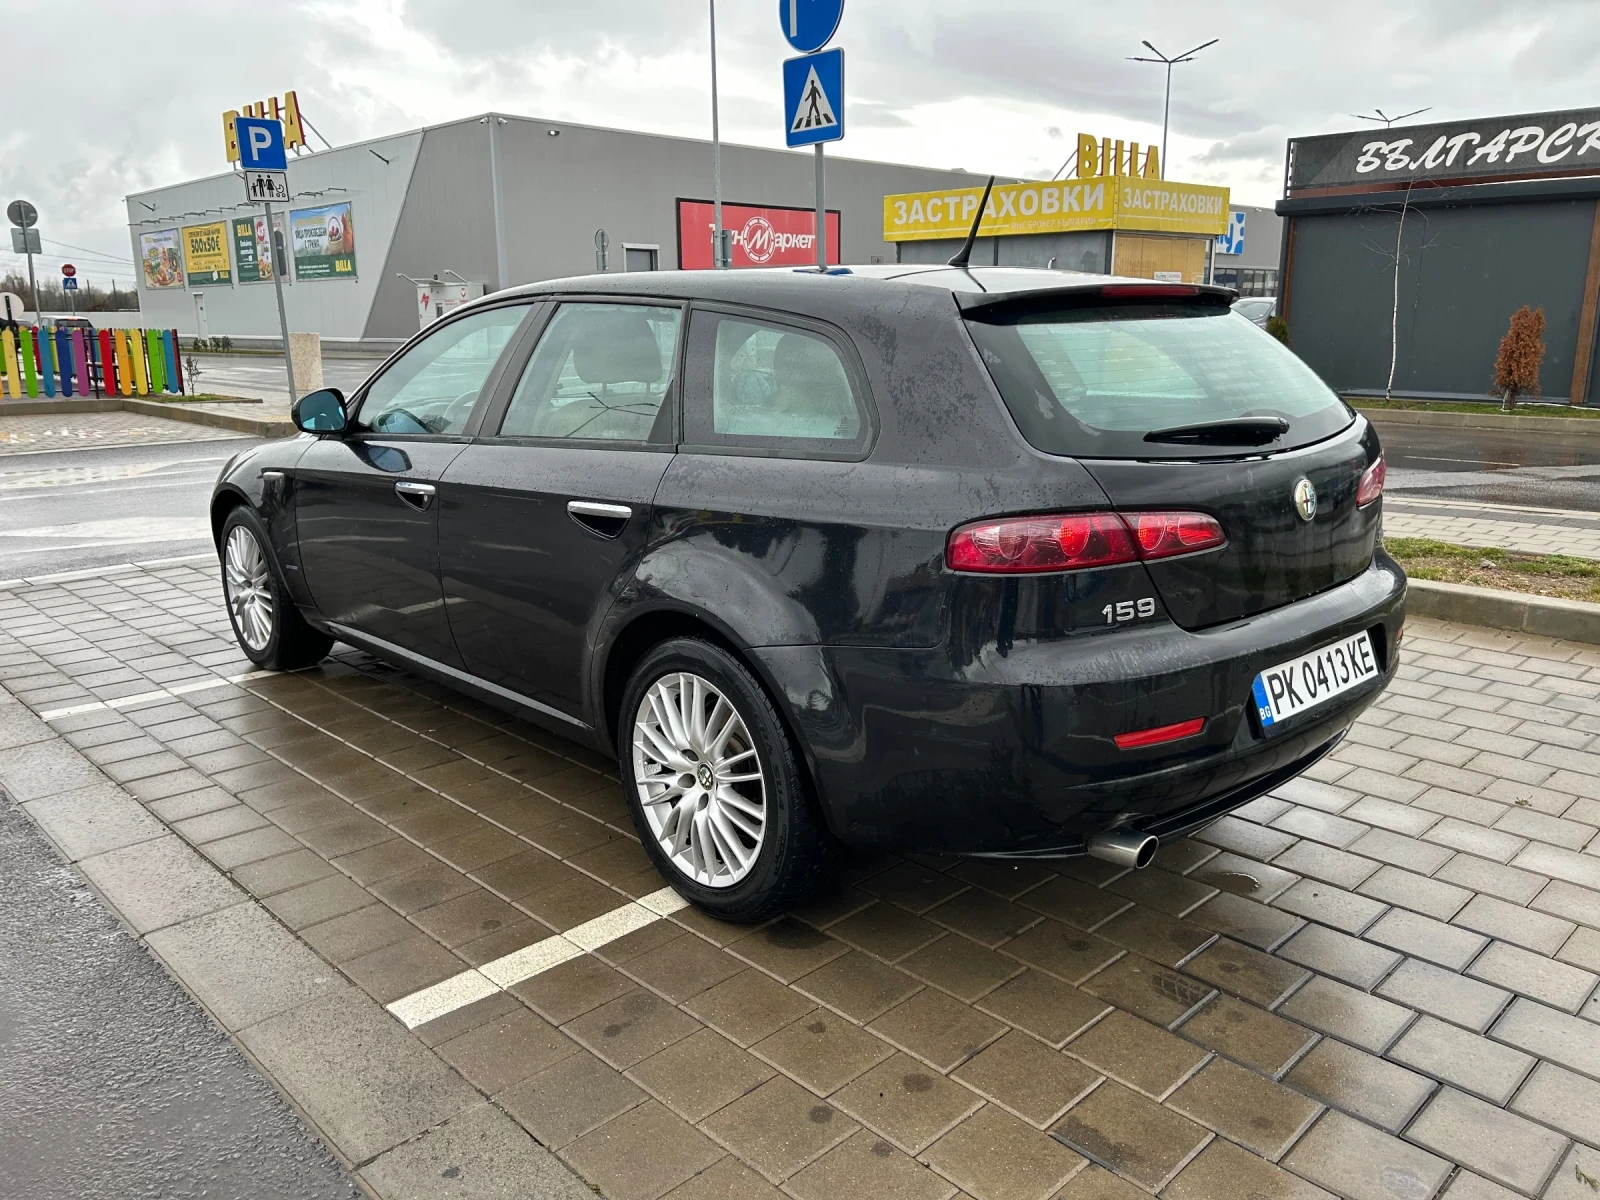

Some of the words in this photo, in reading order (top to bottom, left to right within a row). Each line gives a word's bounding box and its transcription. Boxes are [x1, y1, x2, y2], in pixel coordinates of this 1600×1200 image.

[248, 126, 272, 161] P
[1077, 132, 1160, 180] BILLA
[893, 182, 1105, 225] ЗАСТРАХОВКИ
[1123, 187, 1223, 215] ЗАСТРАХОВКИ
[1028, 219, 1055, 228] БРОКЕР
[1058, 217, 1096, 227] БЪЛГАРИЯ
[335, 259, 352, 272] BILLA
[1101, 597, 1156, 624] 159
[1267, 665, 1304, 715] PK
[1302, 646, 1350, 699] 0413
[1345, 635, 1374, 679] KE
[1259, 704, 1272, 721] BG
